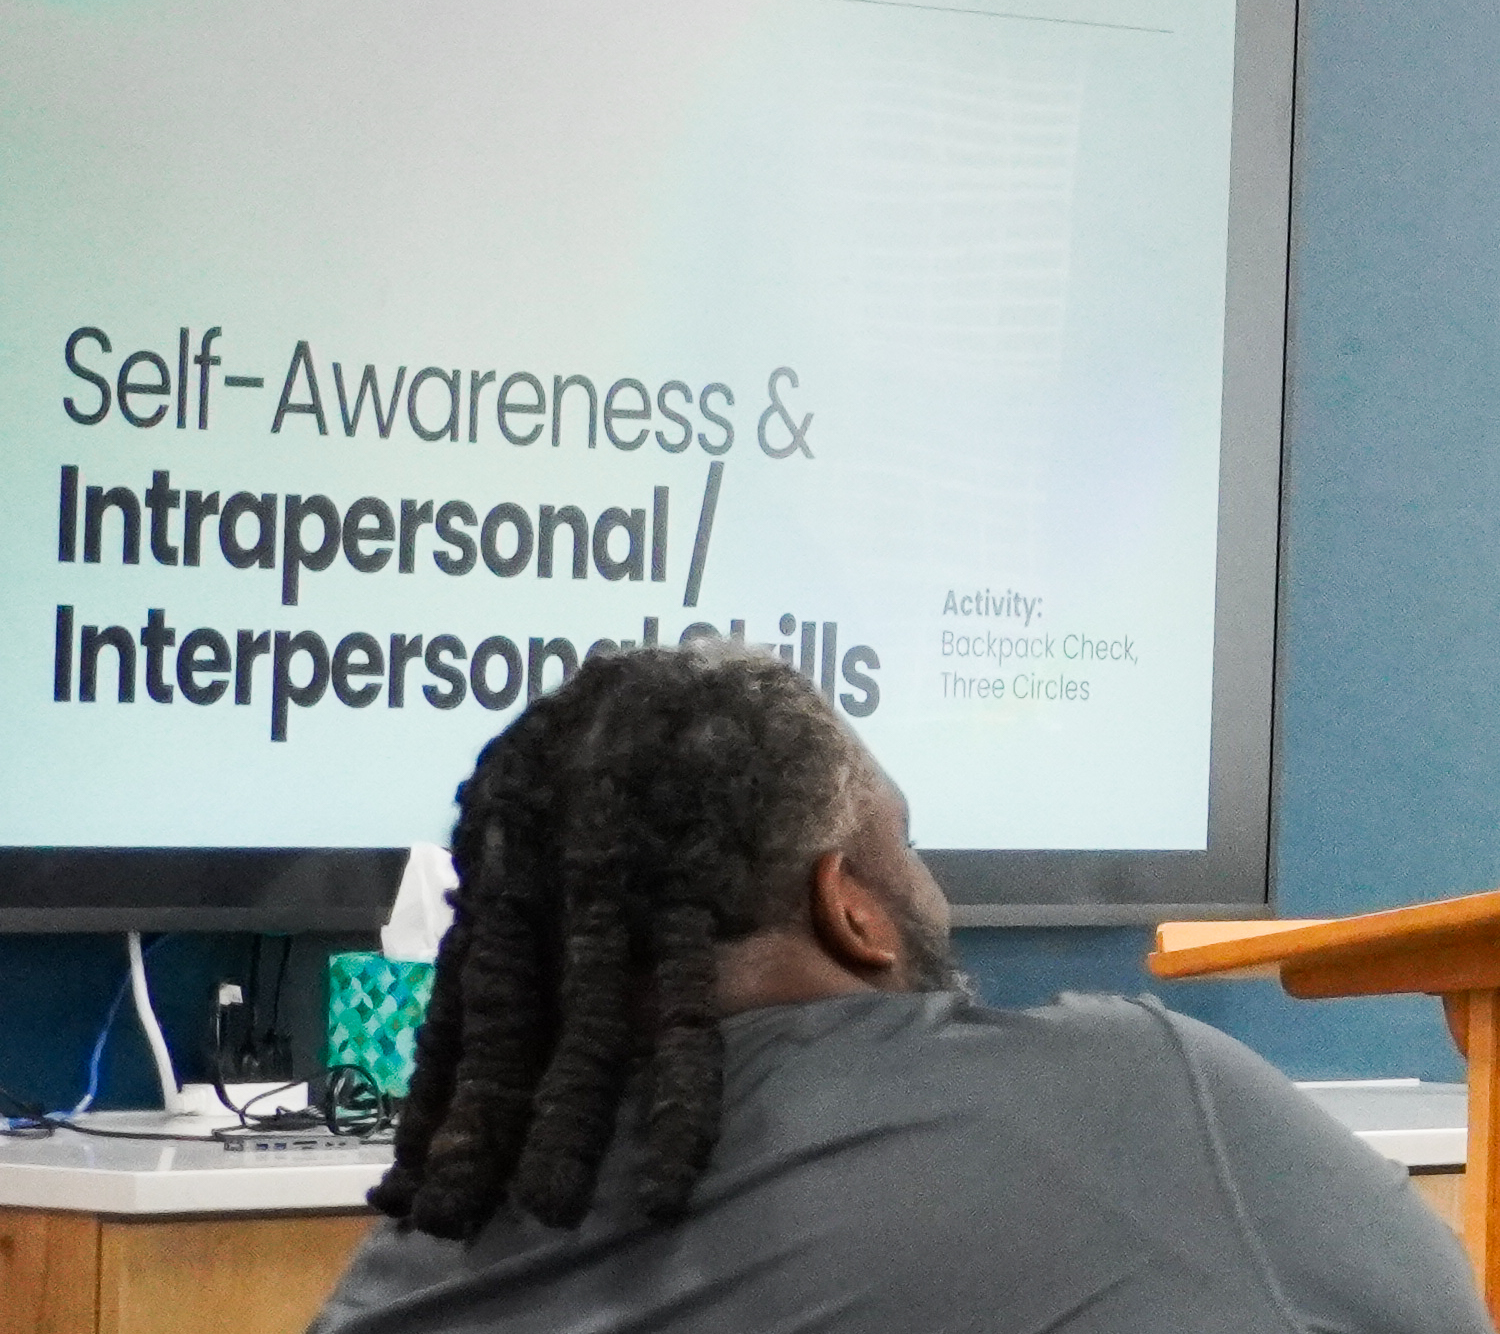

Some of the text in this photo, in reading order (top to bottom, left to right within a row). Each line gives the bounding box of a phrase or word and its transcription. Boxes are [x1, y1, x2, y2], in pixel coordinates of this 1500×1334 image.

[62, 325, 817, 461] Self-Awareness &
[57, 463, 670, 607] Intrapersonal
[941, 630, 1140, 668] Backpack Check,
[942, 587, 1044, 628] Activity:
[52, 604, 882, 742] Interperson ills
[940, 671, 1091, 702] Three Circles
